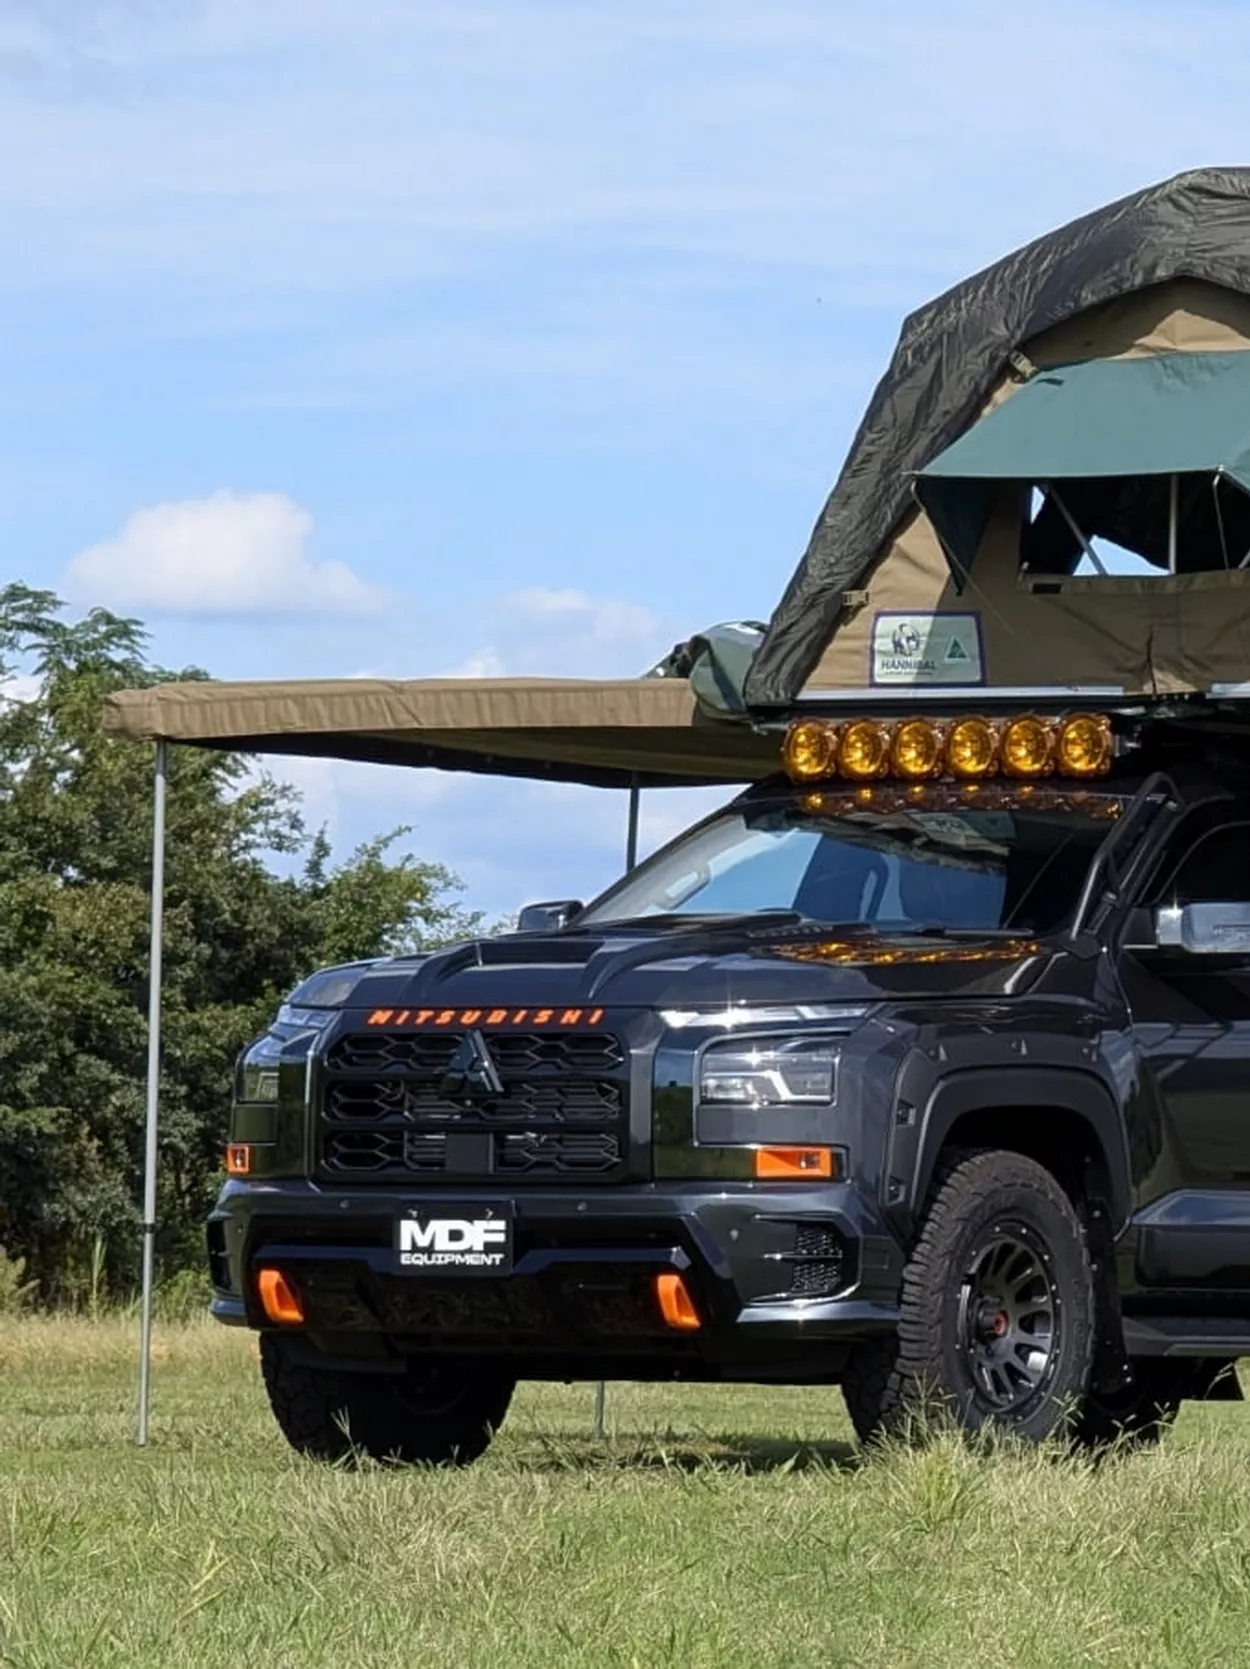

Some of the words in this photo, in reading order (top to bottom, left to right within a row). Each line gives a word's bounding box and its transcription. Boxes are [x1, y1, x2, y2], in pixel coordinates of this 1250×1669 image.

[367, 1009, 605, 1025] MITSUBISHI
[400, 1219, 507, 1251] MDF
[400, 1252, 505, 1265] EQUIPMENT
